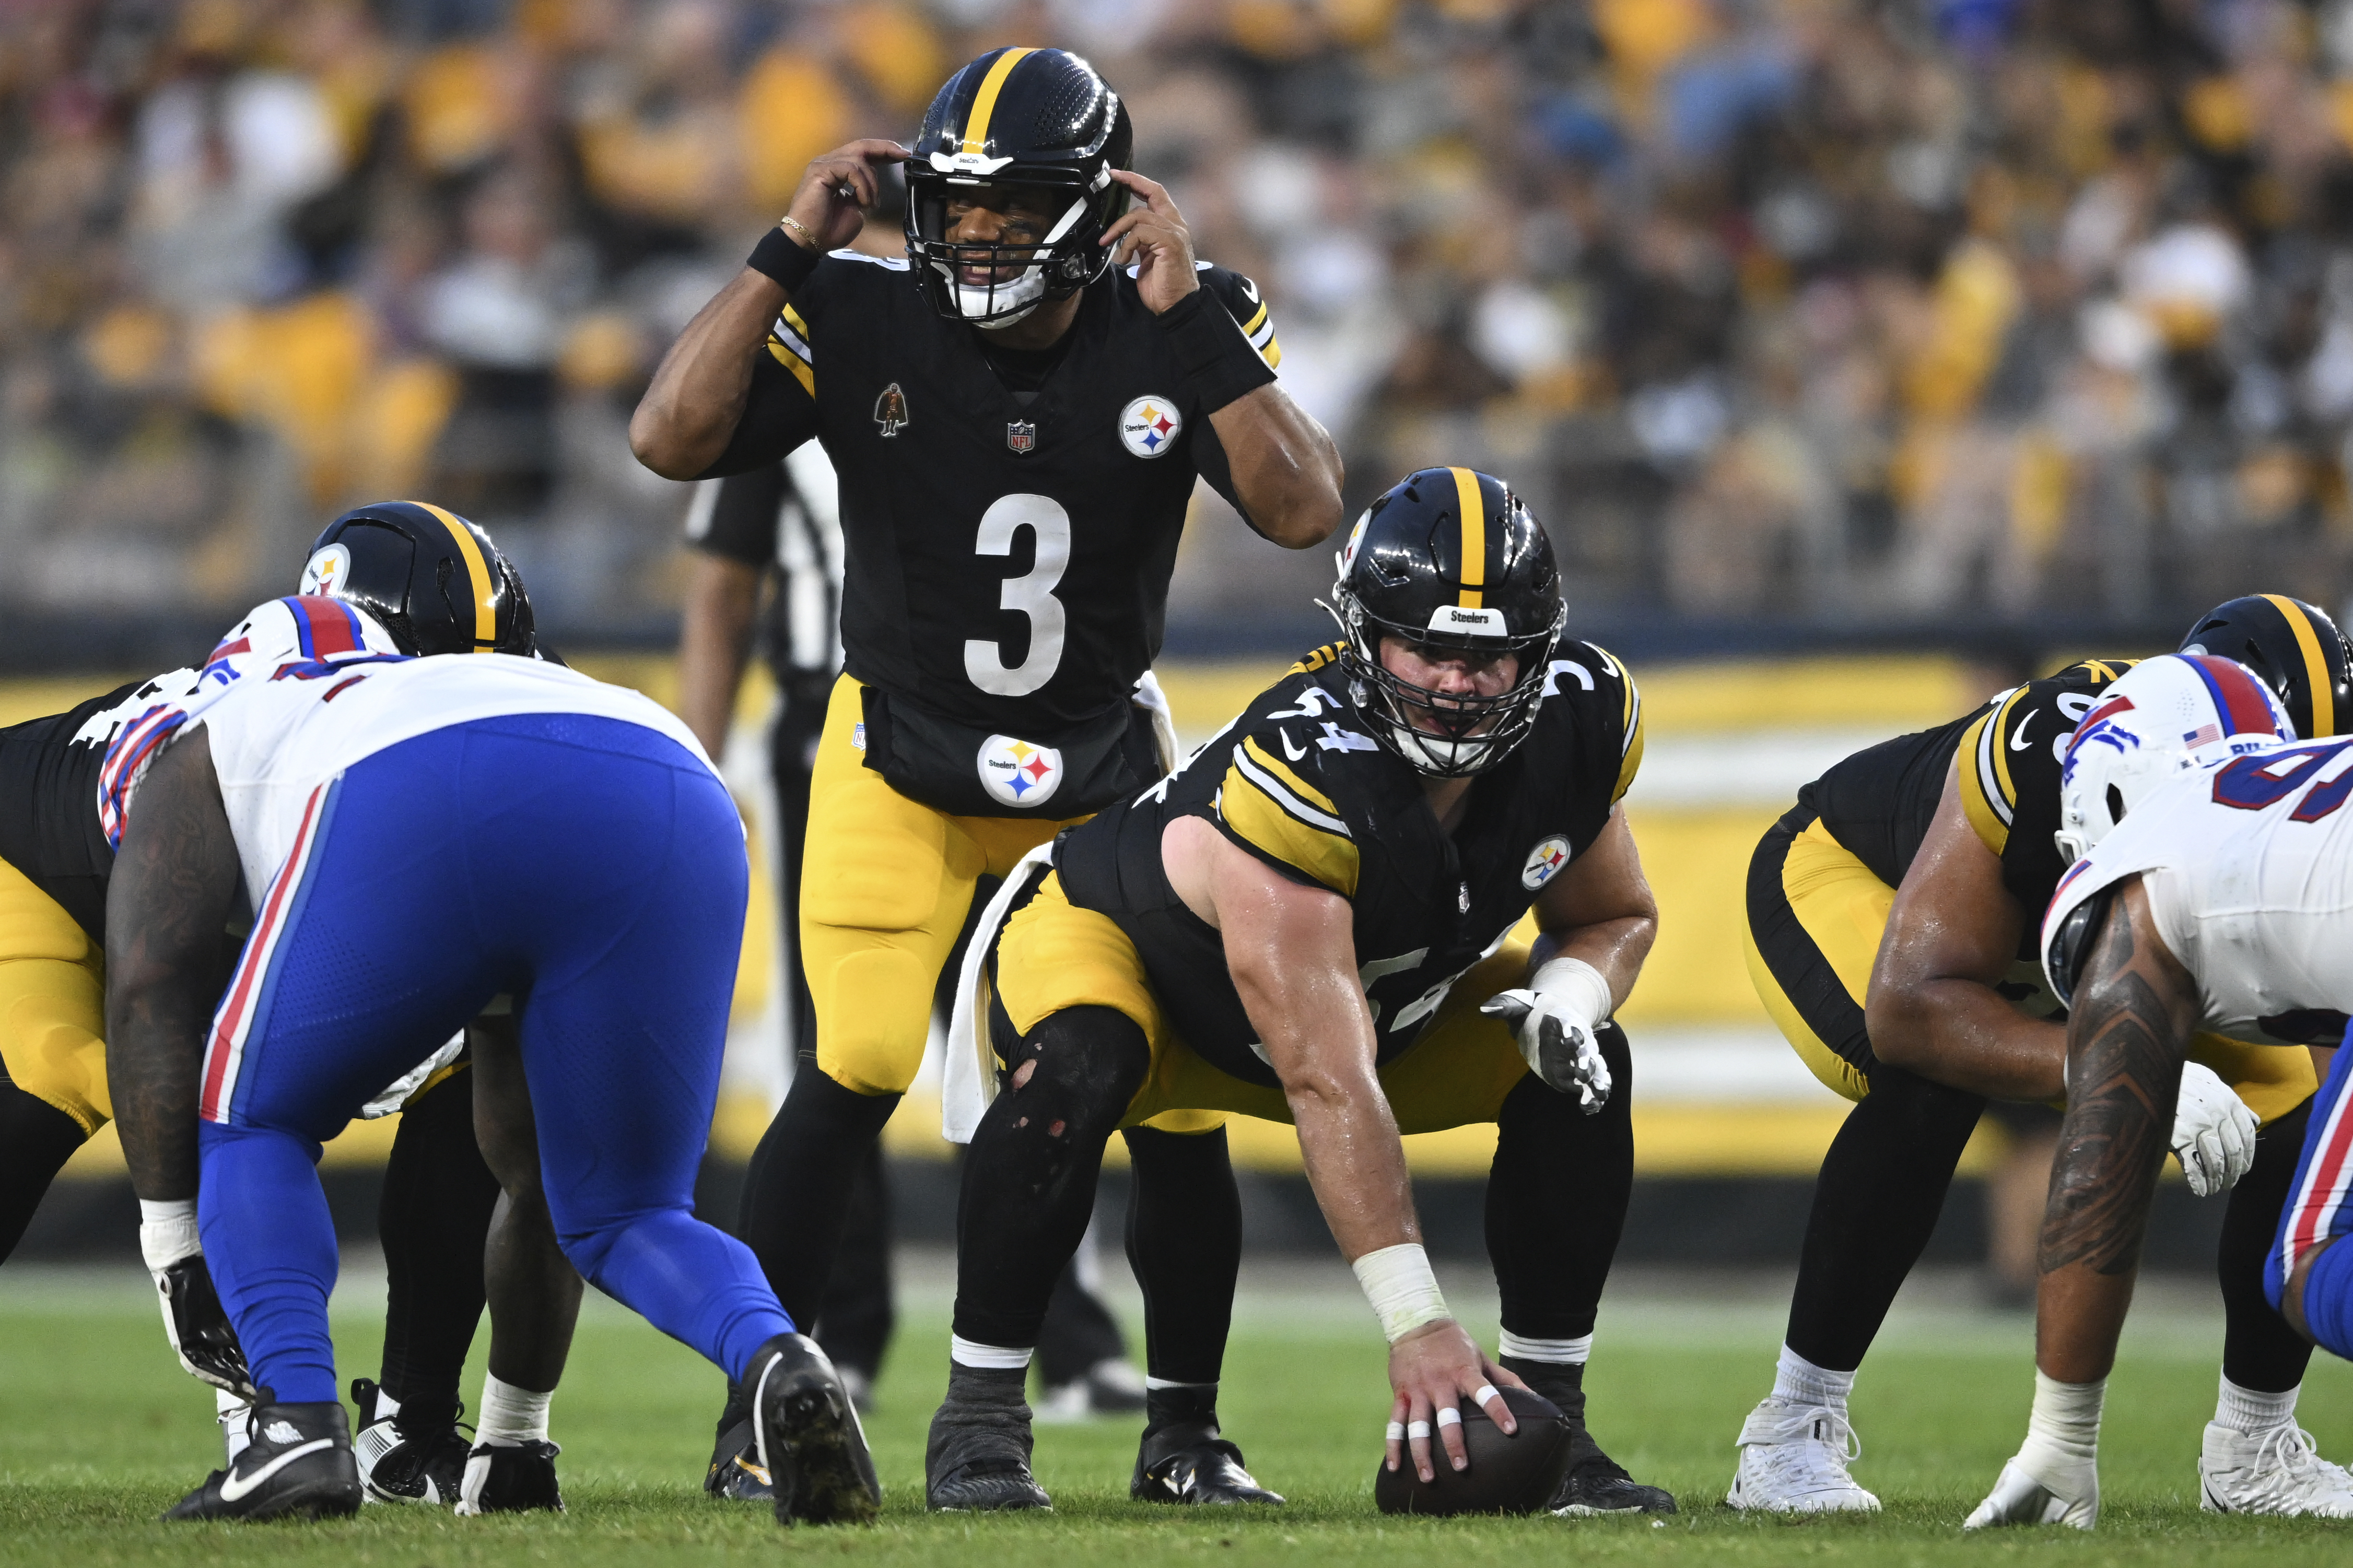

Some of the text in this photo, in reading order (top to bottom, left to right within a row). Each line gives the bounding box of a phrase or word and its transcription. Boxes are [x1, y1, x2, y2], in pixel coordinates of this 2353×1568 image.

[1125, 423, 1149, 432] Steelers
[1012, 436, 1031, 449] NFL
[964, 493, 1071, 697] 3
[1451, 610, 1489, 624] Steelers
[989, 759, 1016, 770] Steelers
